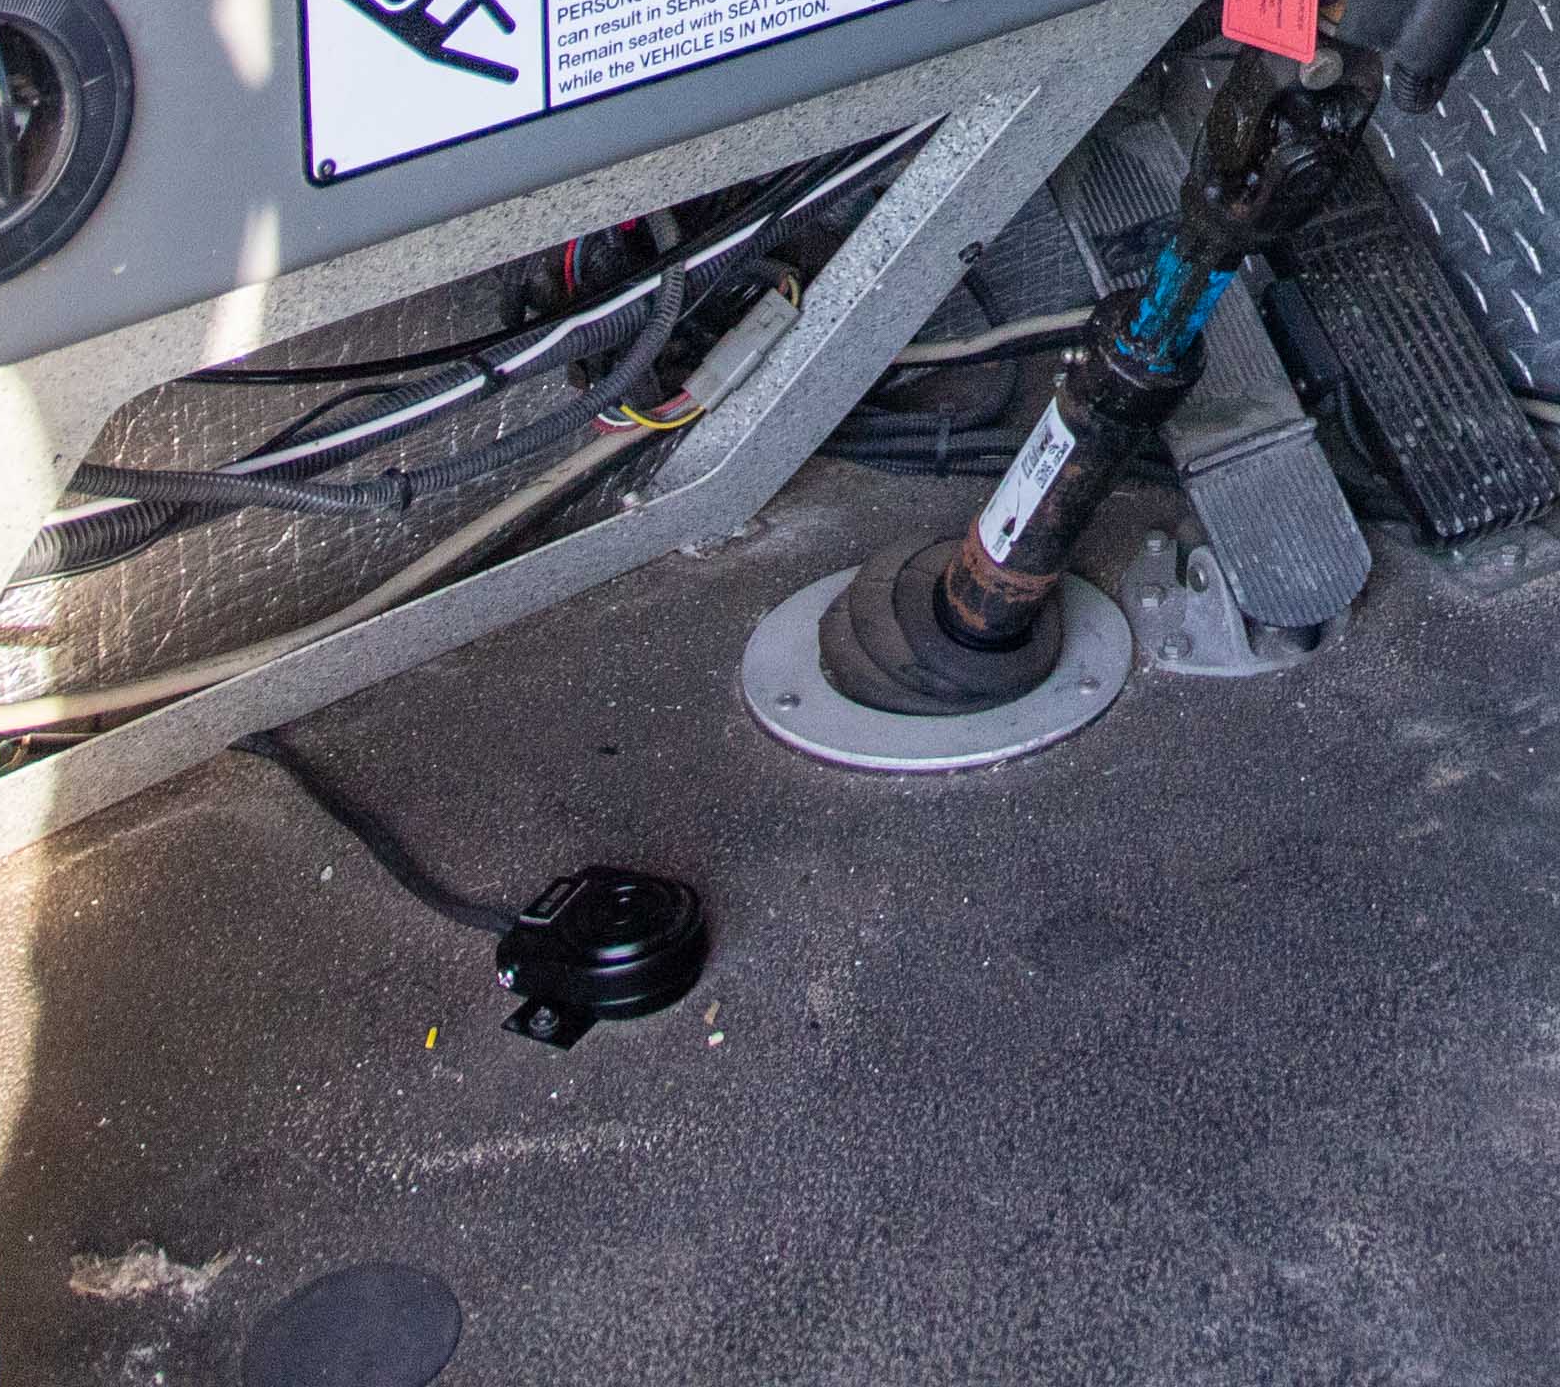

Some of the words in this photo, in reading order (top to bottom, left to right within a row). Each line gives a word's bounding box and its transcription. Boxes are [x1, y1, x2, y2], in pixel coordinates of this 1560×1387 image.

[558, 33, 588, 47] can
[594, 12, 641, 37] result
[647, 6, 661, 21] in
[558, 40, 623, 70] Remain
[629, 20, 684, 50] seated
[690, 11, 723, 31] with
[559, 70, 602, 94] while
[609, 61, 635, 78] the
[640, 33, 714, 67] VEHICLE
[719, 27, 734, 45] IS
[740, 19, 755, 38] IN
